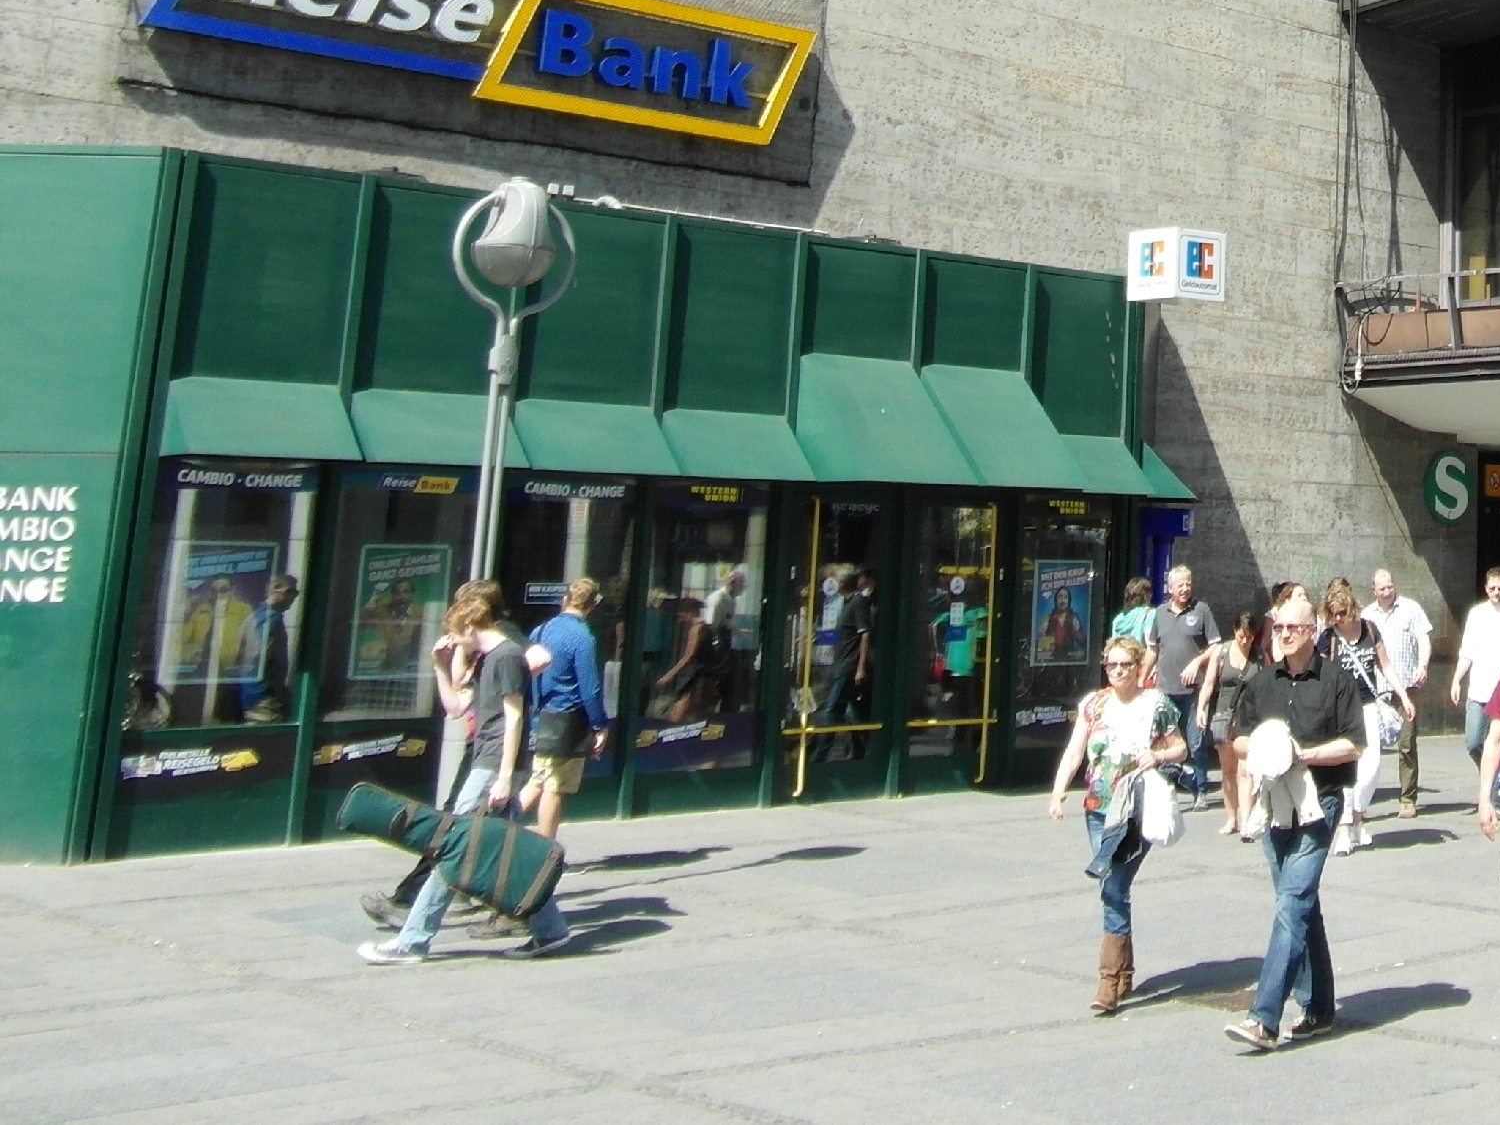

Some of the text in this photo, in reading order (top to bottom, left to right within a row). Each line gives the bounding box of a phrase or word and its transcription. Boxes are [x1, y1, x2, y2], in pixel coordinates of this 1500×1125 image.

[537, 7, 755, 108] Bank
[1181, 279, 1218, 291] Geldautomat
[177, 469, 303, 488] CAMBIO CHANGE
[383, 477, 450, 491] Reise Bank
[524, 481, 625, 498] CAMBIO CHANGE
[691, 486, 737, 495] WESTERN
[1435, 456, 1469, 520] S
[704, 494, 737, 503] UNION
[1049, 500, 1085, 508] WESTERN
